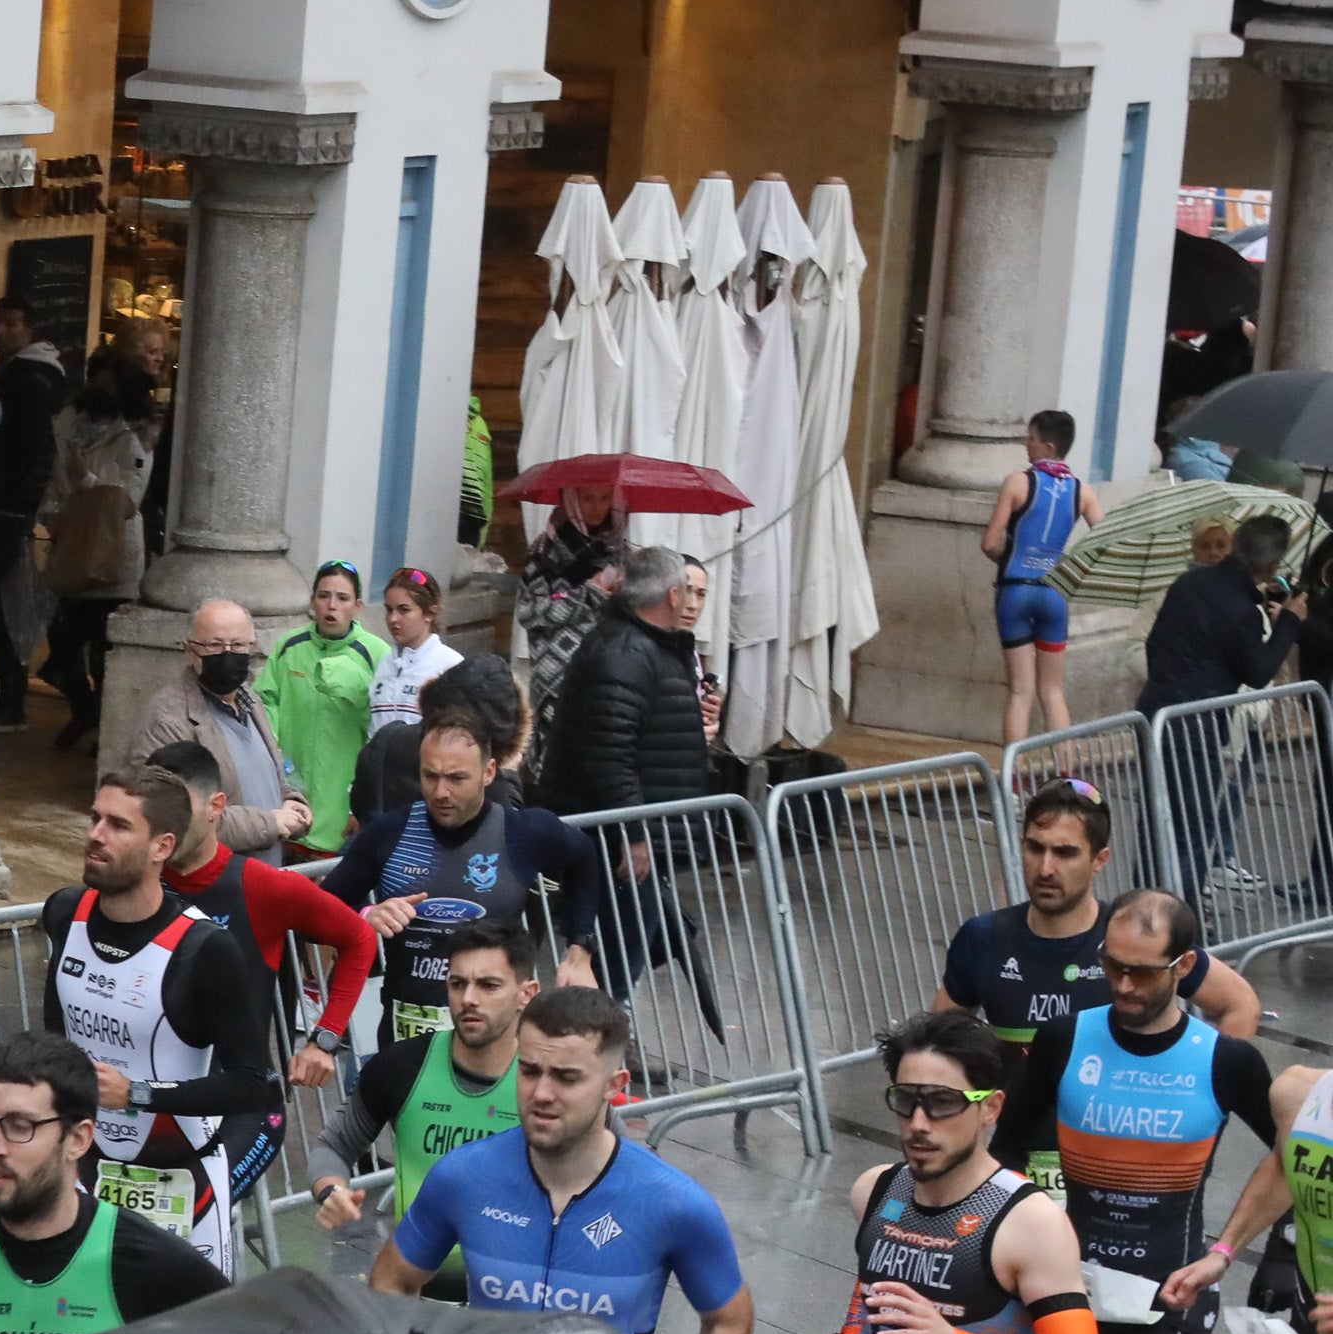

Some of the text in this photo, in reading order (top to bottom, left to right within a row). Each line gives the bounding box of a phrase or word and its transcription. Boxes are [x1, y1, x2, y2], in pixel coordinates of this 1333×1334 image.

[423, 902, 469, 922] Ford
[67, 1004, 135, 1051] SEGARRA
[1028, 993, 1071, 1022] AZON
[1081, 1096, 1184, 1140] ÁLVAREZ
[98, 1186, 156, 1212] 4165
[867, 1239, 953, 1284] MARTÍNEZ
[479, 1273, 616, 1315] GARCIA
